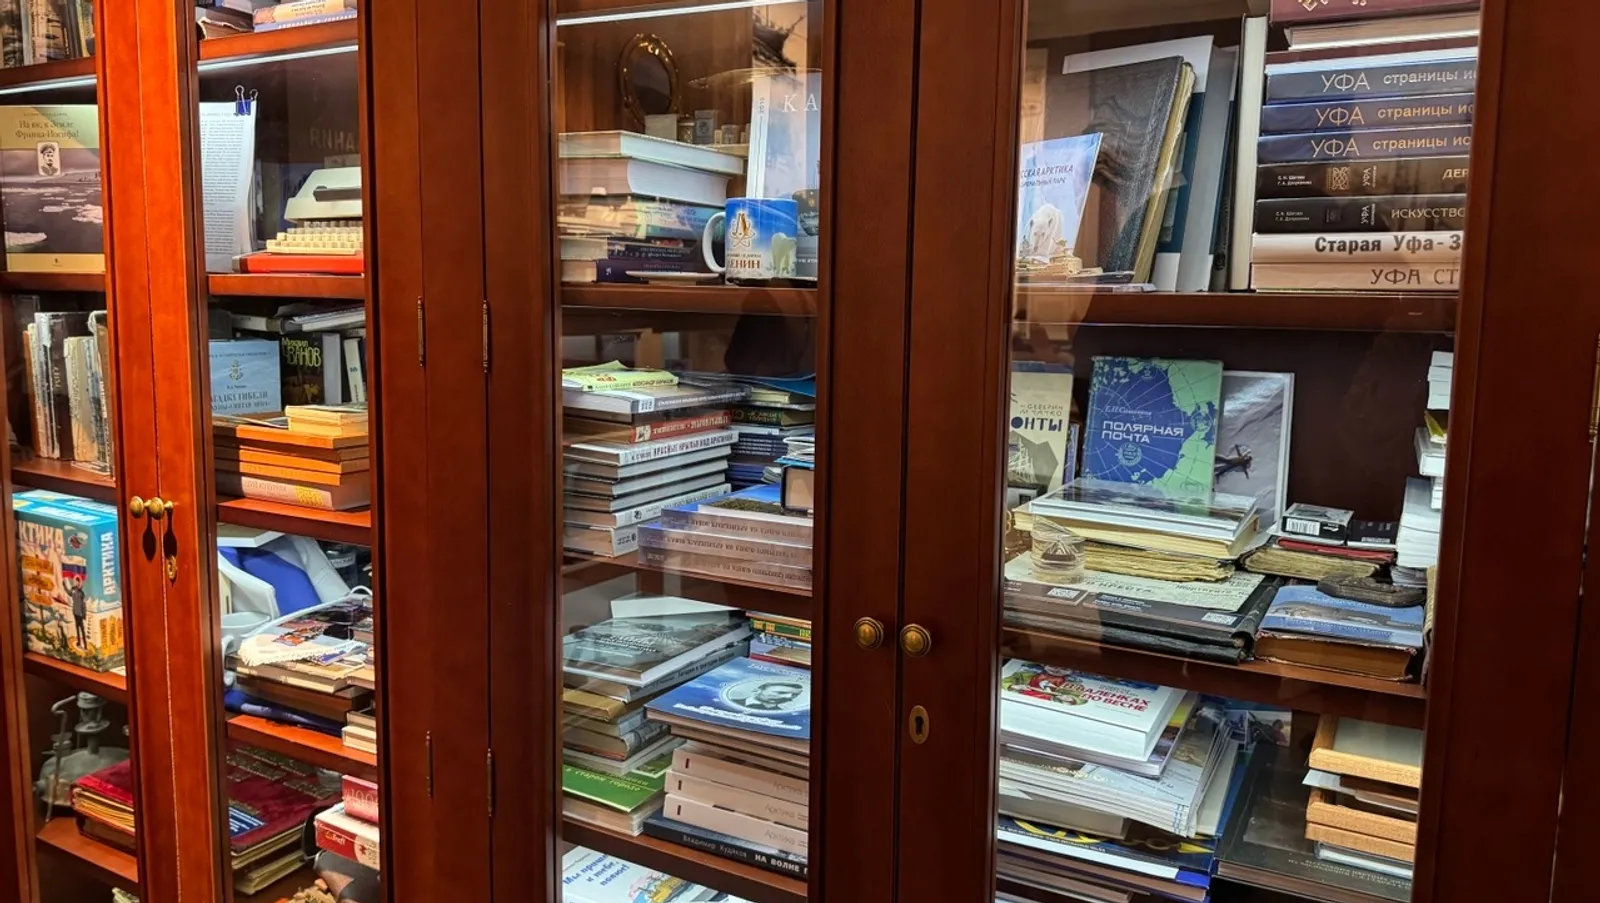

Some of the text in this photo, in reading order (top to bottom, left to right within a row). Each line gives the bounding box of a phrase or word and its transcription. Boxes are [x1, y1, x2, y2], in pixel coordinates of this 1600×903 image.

[1321, 72, 1370, 92] УФА
[1383, 69, 1458, 86] страницы
[1316, 106, 1365, 126] УФА
[1378, 104, 1452, 121] страницы
[1311, 138, 1360, 158] УФА
[1372, 136, 1447, 152] страницы
[1315, 237, 1382, 255] Старая
[1370, 268, 1421, 285] УФА
[282, 337, 309, 348] Михаил
[1102, 431, 1150, 443] ПОЧТА
[1103, 421, 1184, 436] ПОЛЯРНАЯ
[101, 531, 117, 596] АРКТИКА
[1103, 698, 1147, 712] ВЕСНЕ
[682, 834, 800, 872] Владимир Худяков НА ВОЛНЕ
[562, 873, 581, 885] Мы
